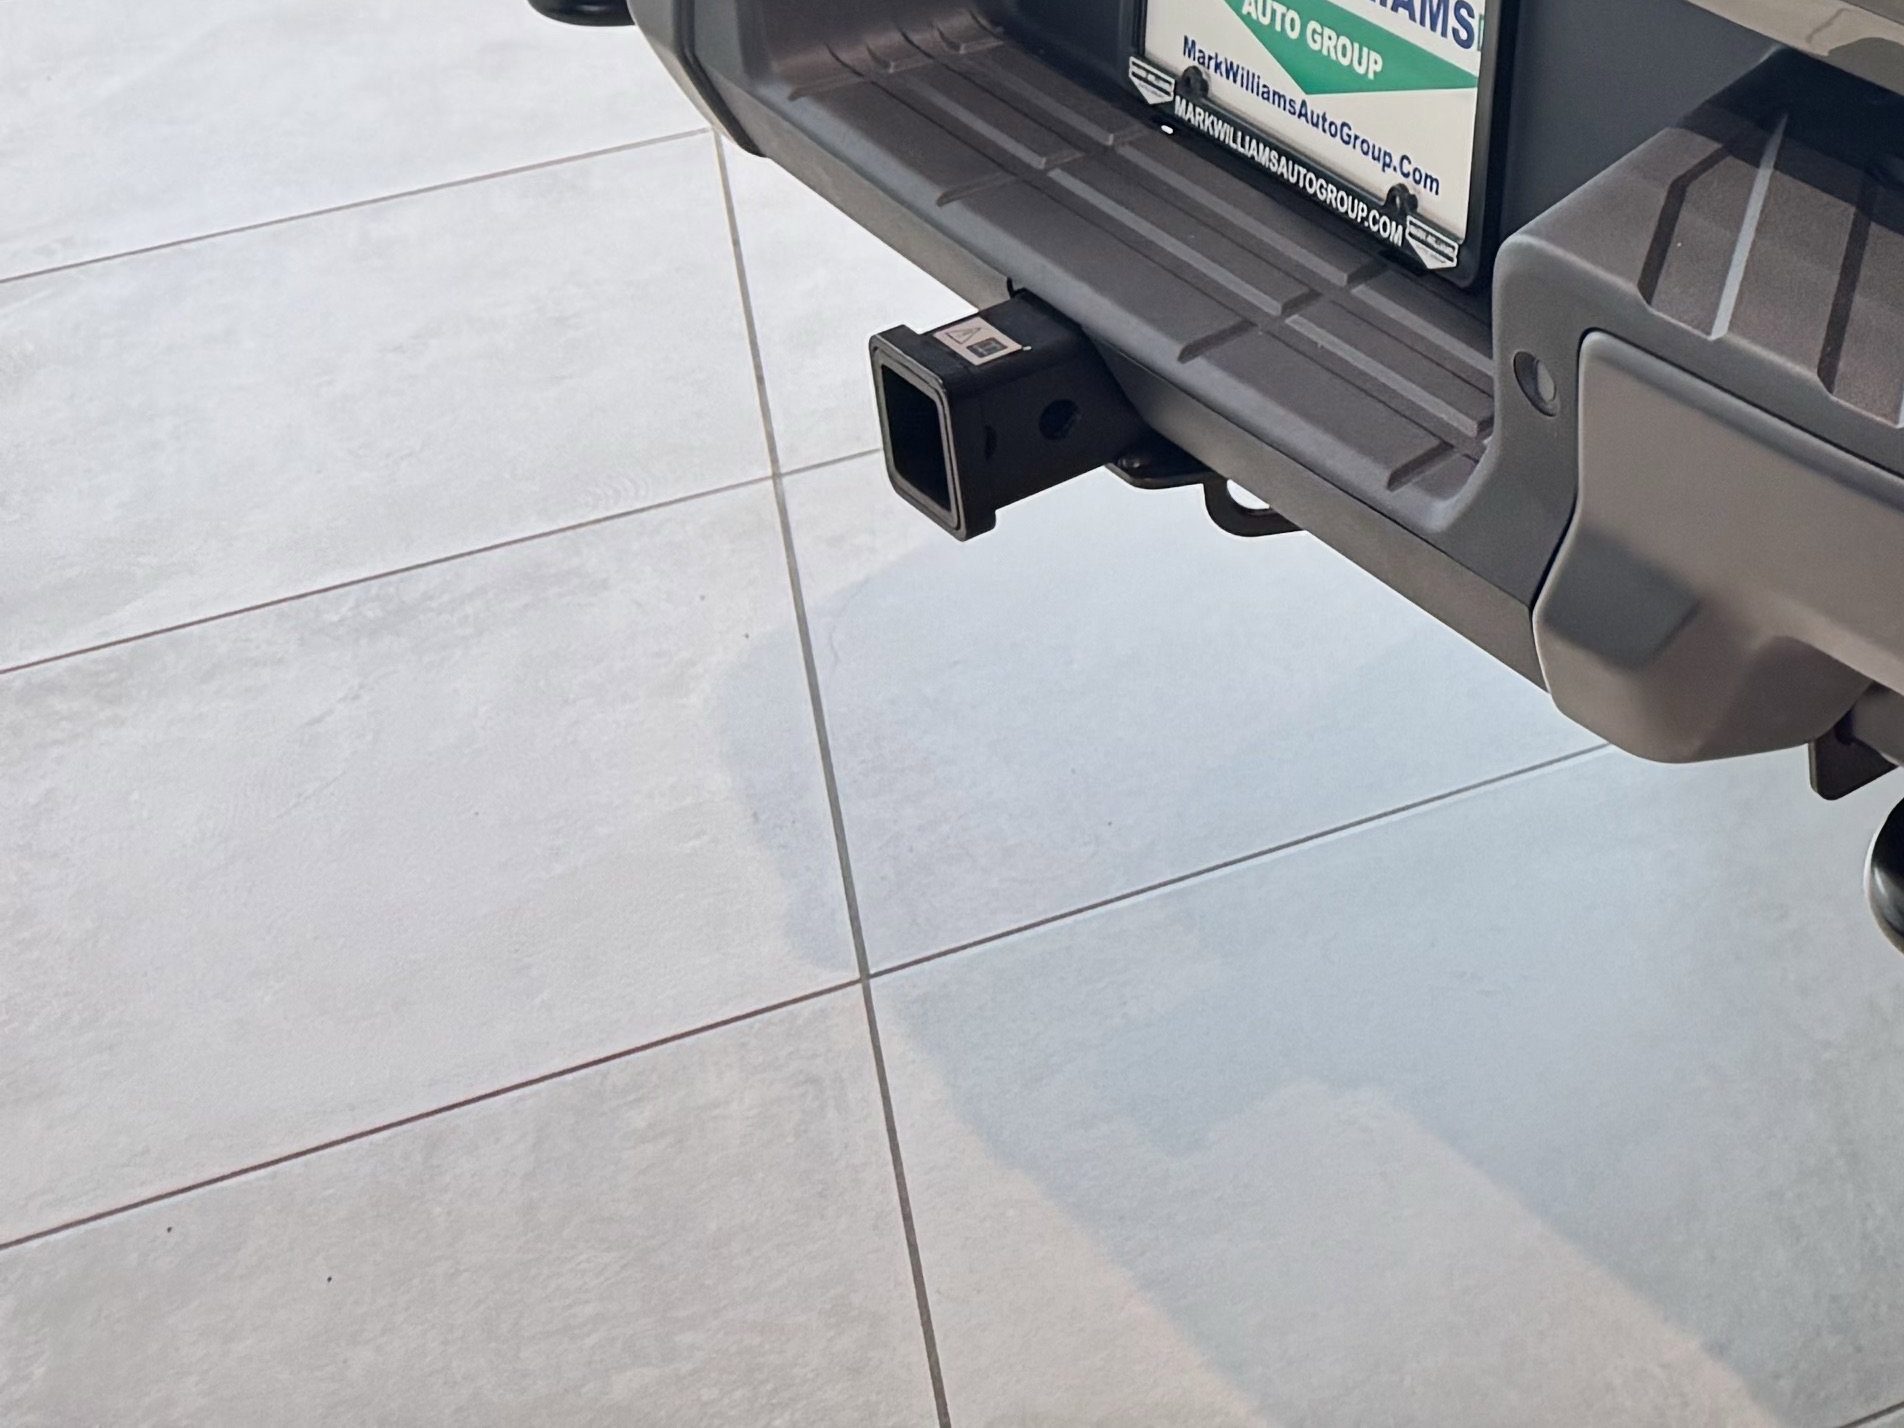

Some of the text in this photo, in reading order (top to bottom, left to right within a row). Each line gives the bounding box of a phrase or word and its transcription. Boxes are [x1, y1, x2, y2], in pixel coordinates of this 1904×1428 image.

[1182, 35, 1441, 197] MarkWilliamsAutoGroup.Com
[1306, 20, 1384, 81] GROUP
[1173, 95, 1404, 247] MARKWILLIAMSAUTOGROUP.COM
